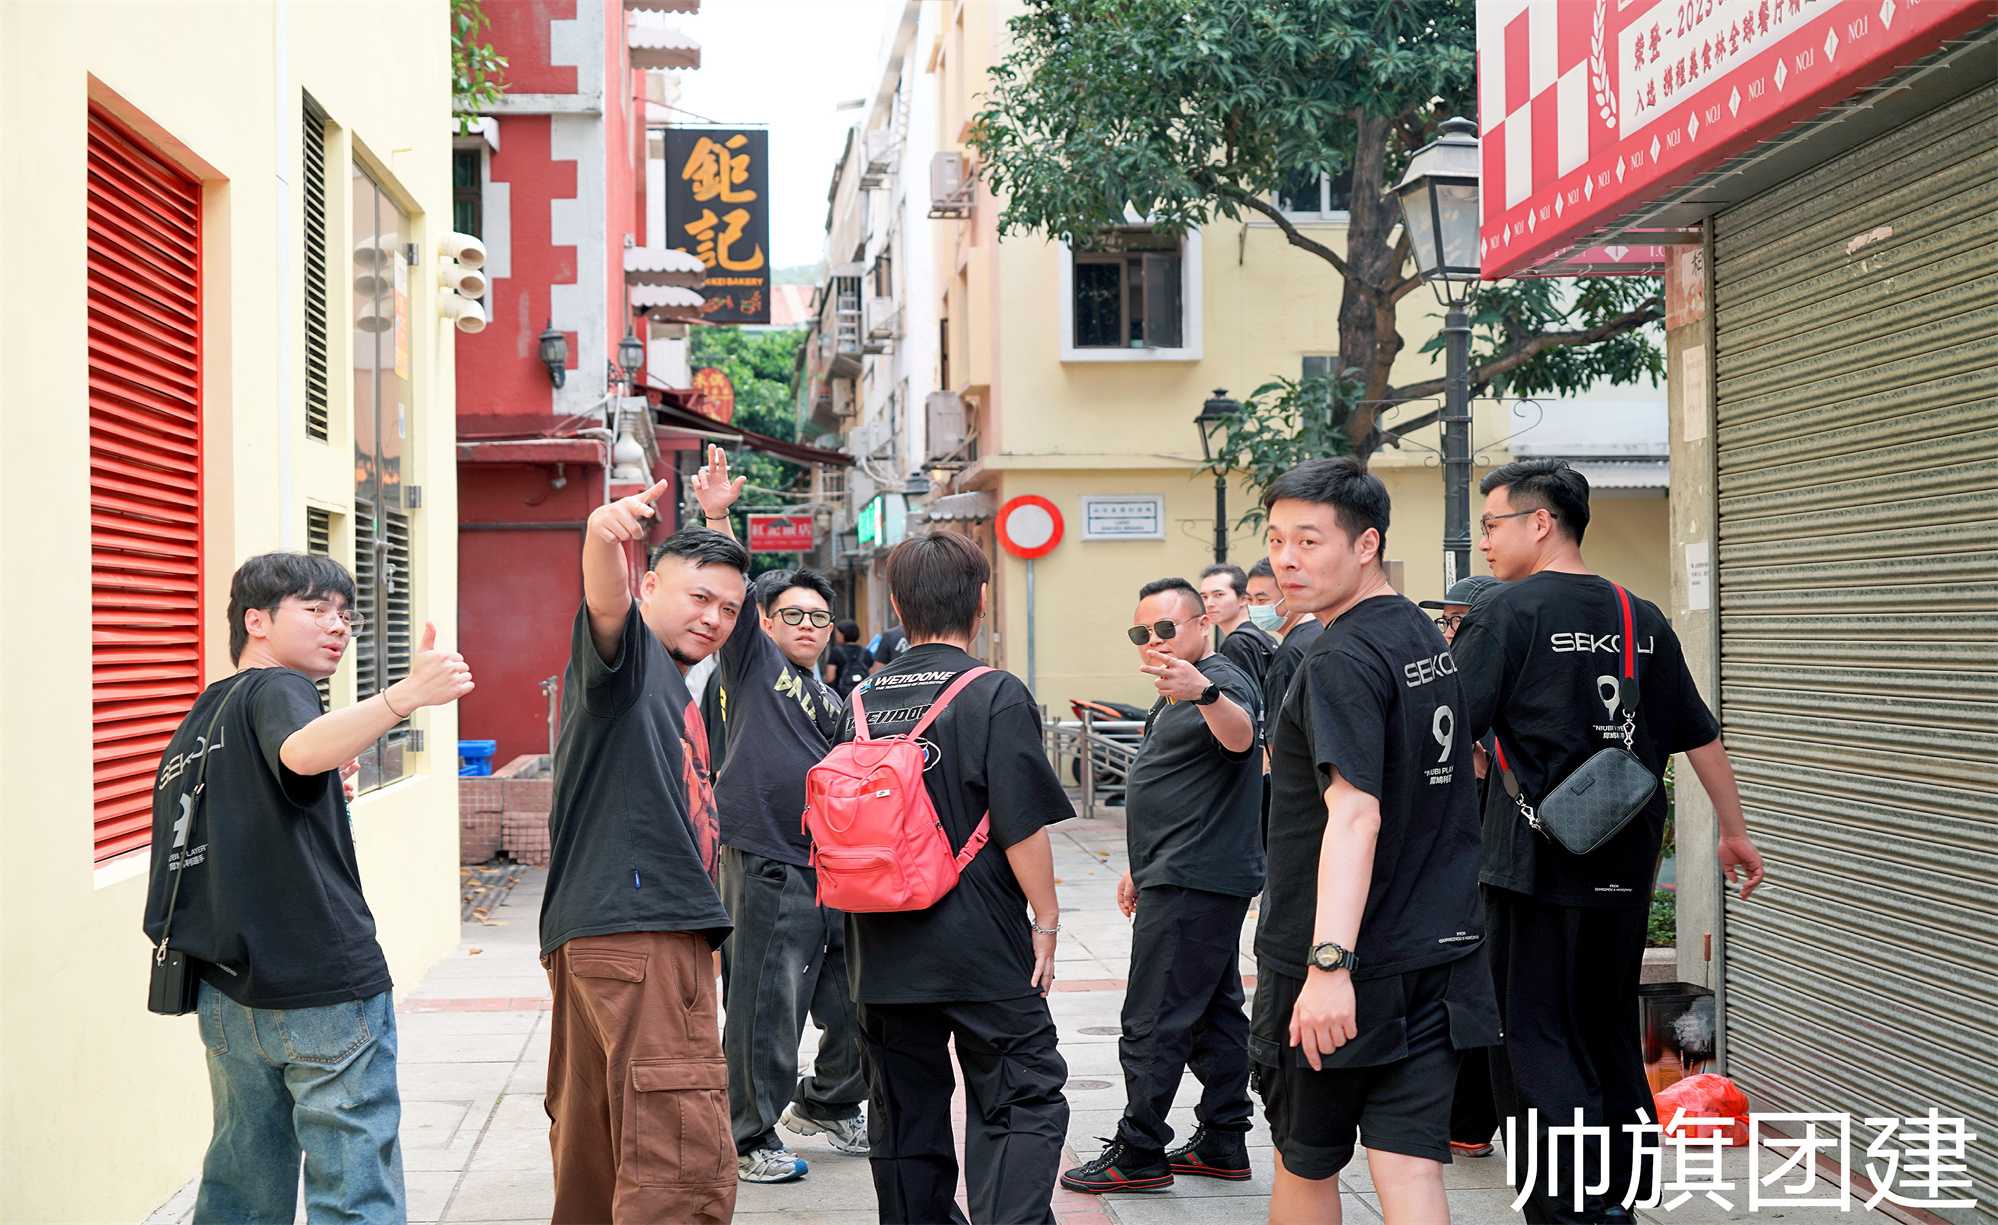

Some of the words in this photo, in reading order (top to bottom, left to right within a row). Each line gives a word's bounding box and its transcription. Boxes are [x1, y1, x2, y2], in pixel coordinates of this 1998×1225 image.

[1666, 128, 1681, 150] NO.1
[1704, 104, 1721, 126] NO.1
[1748, 77, 1765, 101] NO.1
[1795, 48, 1814, 74] NO.1
[1848, 16, 1868, 43] NO.1
[1433, 705, 1454, 763] 9
